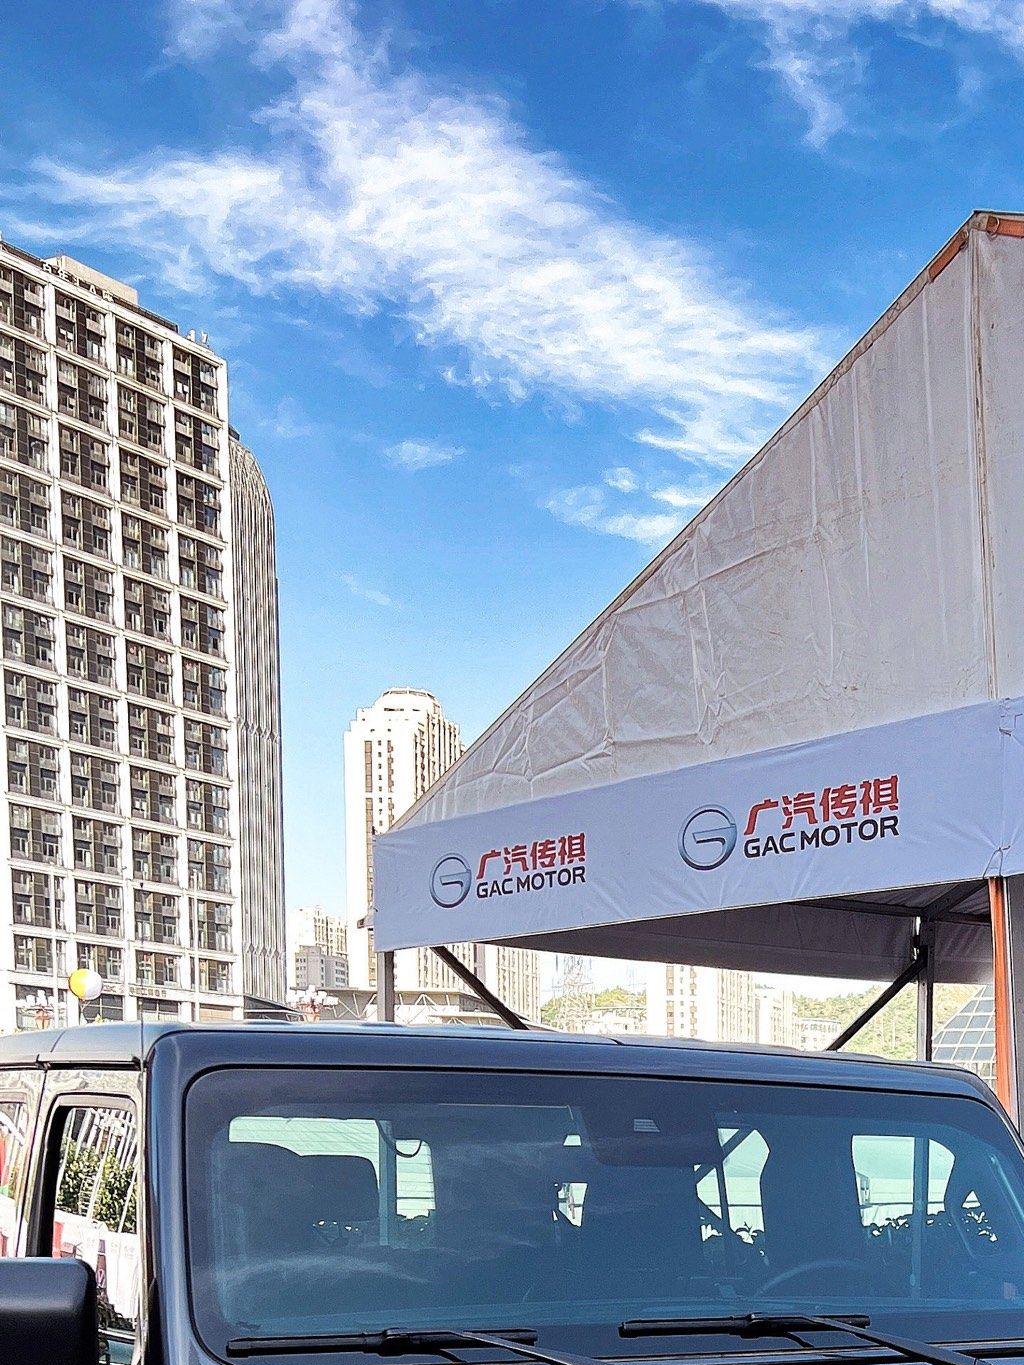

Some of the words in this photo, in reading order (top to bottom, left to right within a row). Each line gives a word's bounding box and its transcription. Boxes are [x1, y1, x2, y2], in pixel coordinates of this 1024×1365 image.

[746, 774, 898, 836] 广汽传祺
[476, 832, 586, 880] 广汽传祺
[743, 832, 797, 859] GAC
[800, 815, 900, 851] MOTOR
[476, 876, 515, 899] GAC
[517, 865, 586, 893] MOTOR
